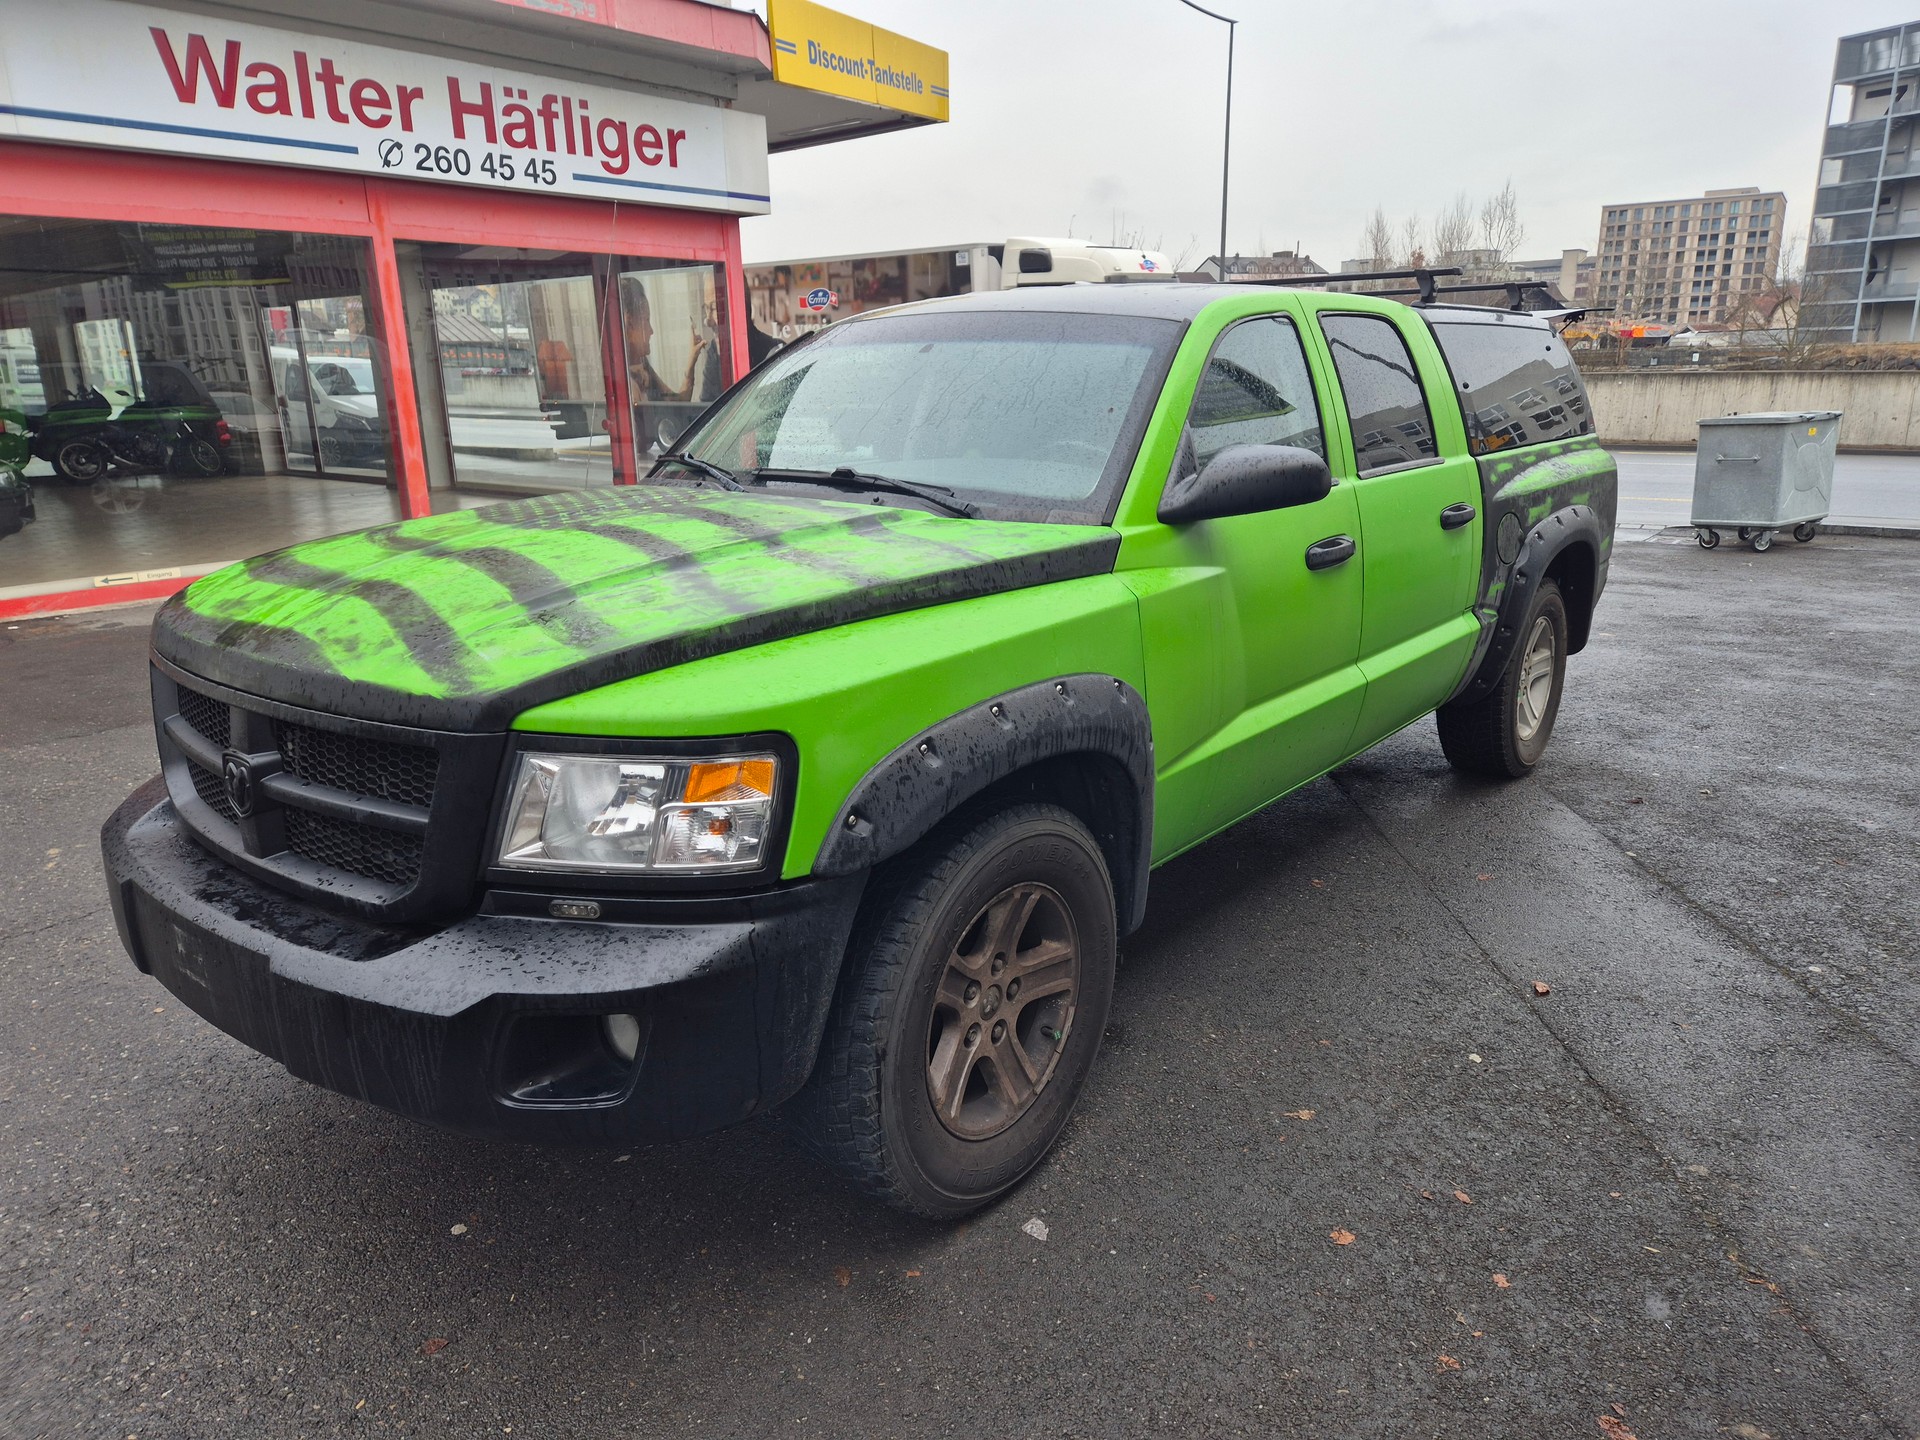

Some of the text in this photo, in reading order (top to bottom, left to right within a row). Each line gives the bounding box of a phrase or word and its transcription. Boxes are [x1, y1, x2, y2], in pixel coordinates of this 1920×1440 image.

[807, 39, 924, 95] Discount-Tankstelle
[149, 26, 687, 175] Walter Häfliger
[414, 143, 558, 186] 260 45 45
[808, 293, 829, 304] Emmi
[771, 321, 791, 339] Le
[147, 571, 173, 579] Eingang
[941, 842, 1073, 952] ICE POWER
